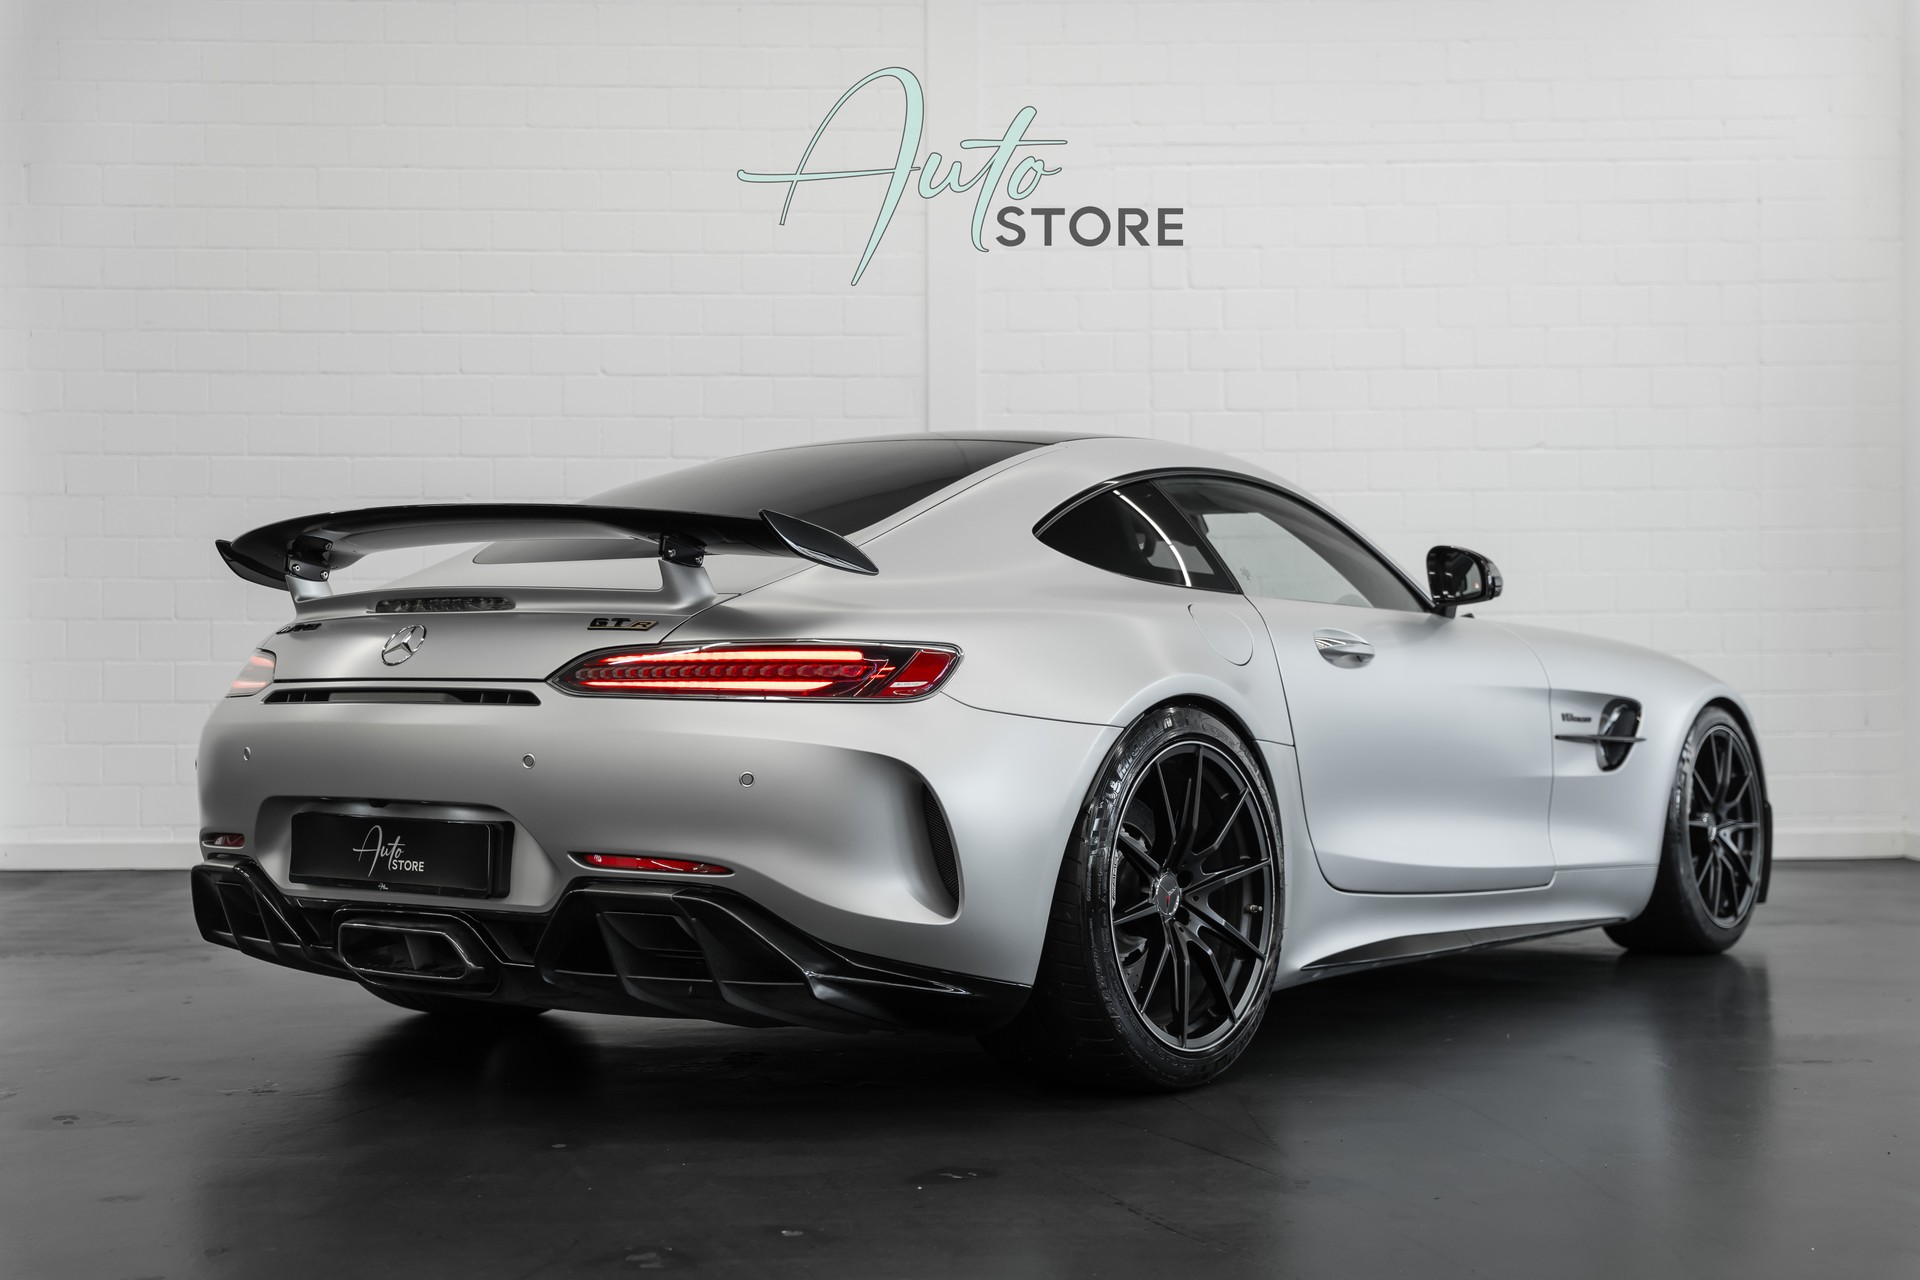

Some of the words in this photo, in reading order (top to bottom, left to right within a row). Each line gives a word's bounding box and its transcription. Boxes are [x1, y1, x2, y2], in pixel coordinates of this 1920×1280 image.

[737, 66, 1068, 286] Auto
[995, 206, 1184, 247] STORE
[352, 825, 406, 877] Auto
[392, 859, 425, 872] STORE
